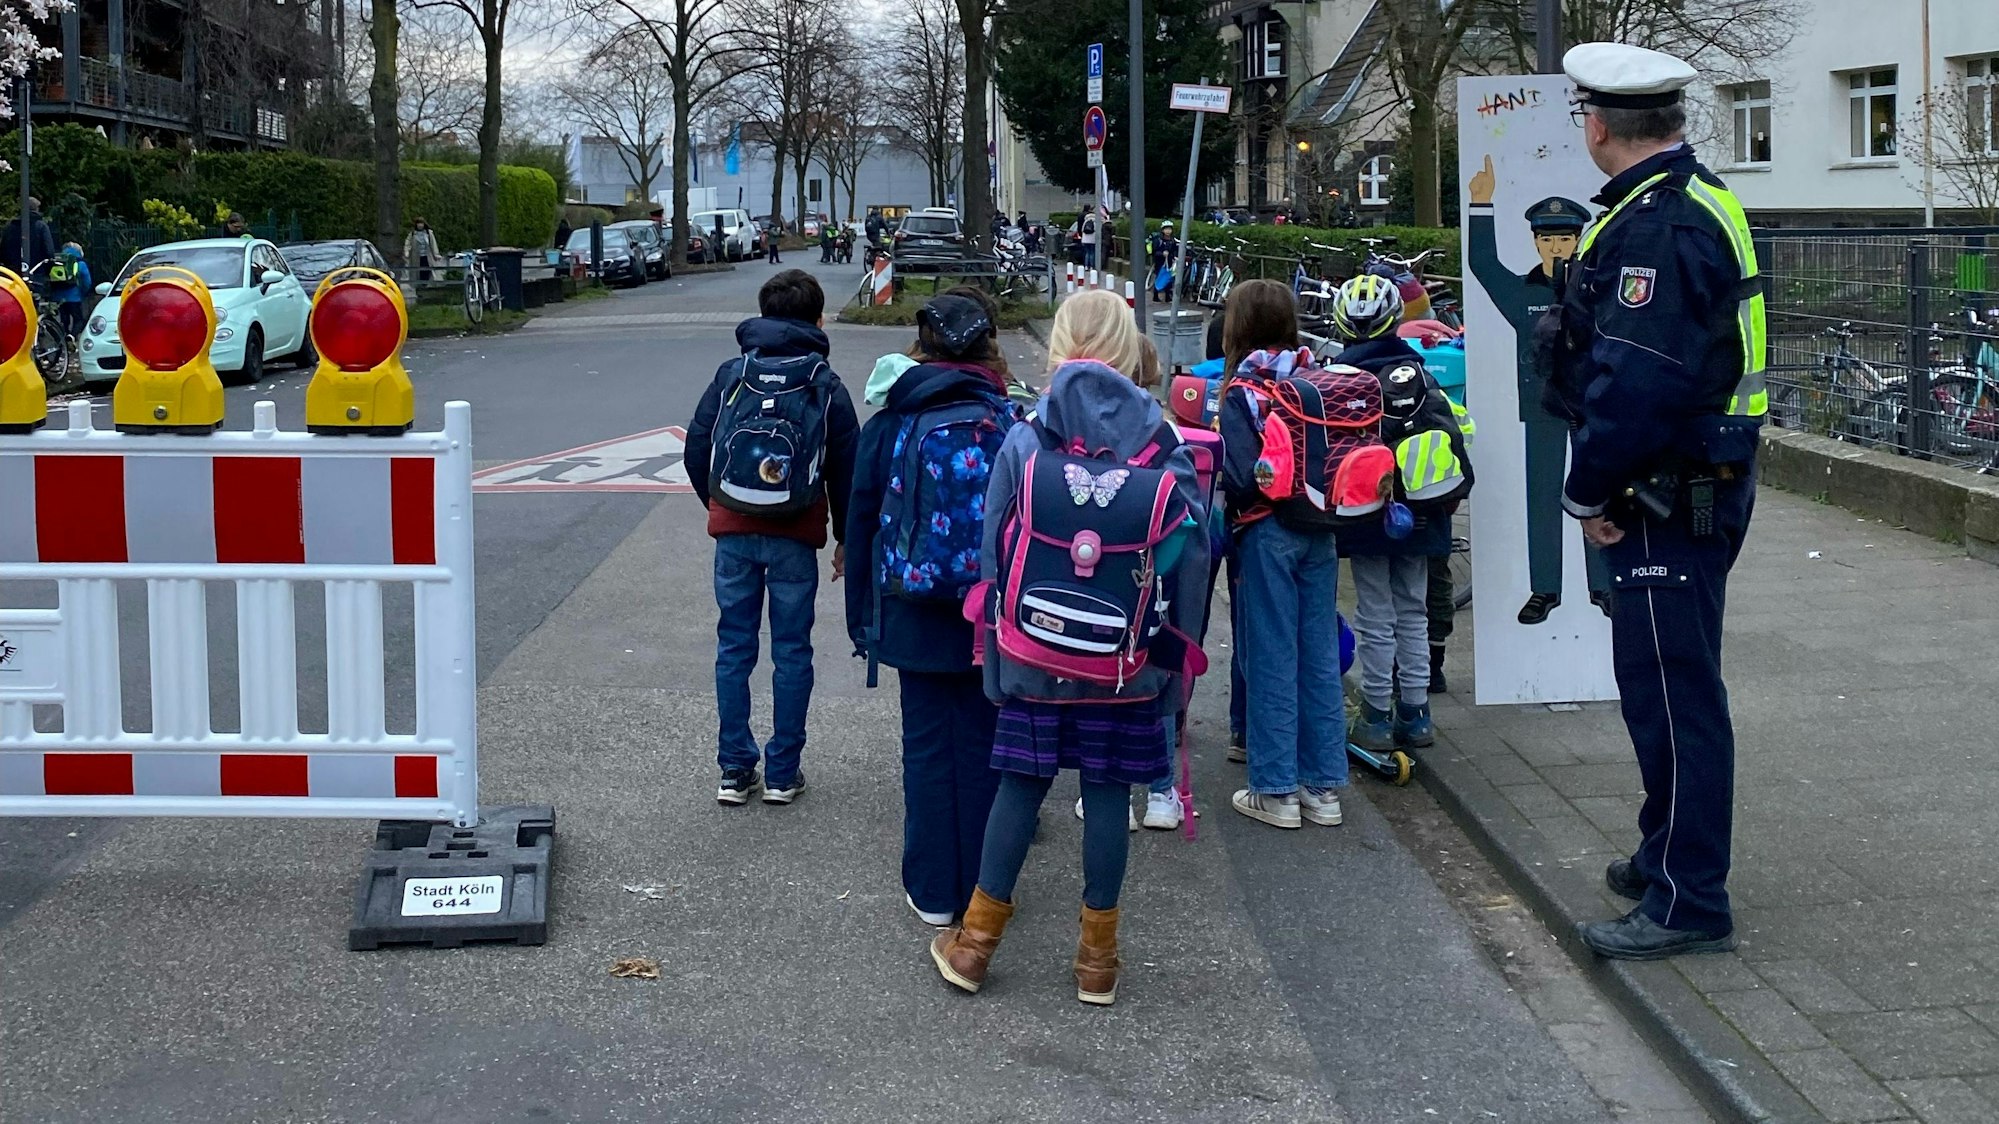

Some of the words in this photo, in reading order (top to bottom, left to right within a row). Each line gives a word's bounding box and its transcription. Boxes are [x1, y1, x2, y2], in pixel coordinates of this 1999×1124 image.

[1175, 91, 1225, 103] Feuerwehrzufahrt
[1623, 268, 1653, 278] POLIZEI
[1631, 566, 1668, 578] POLIZEI
[412, 885, 453, 896] Stadt
[459, 883, 495, 895] Köln
[432, 898, 472, 908] 644
